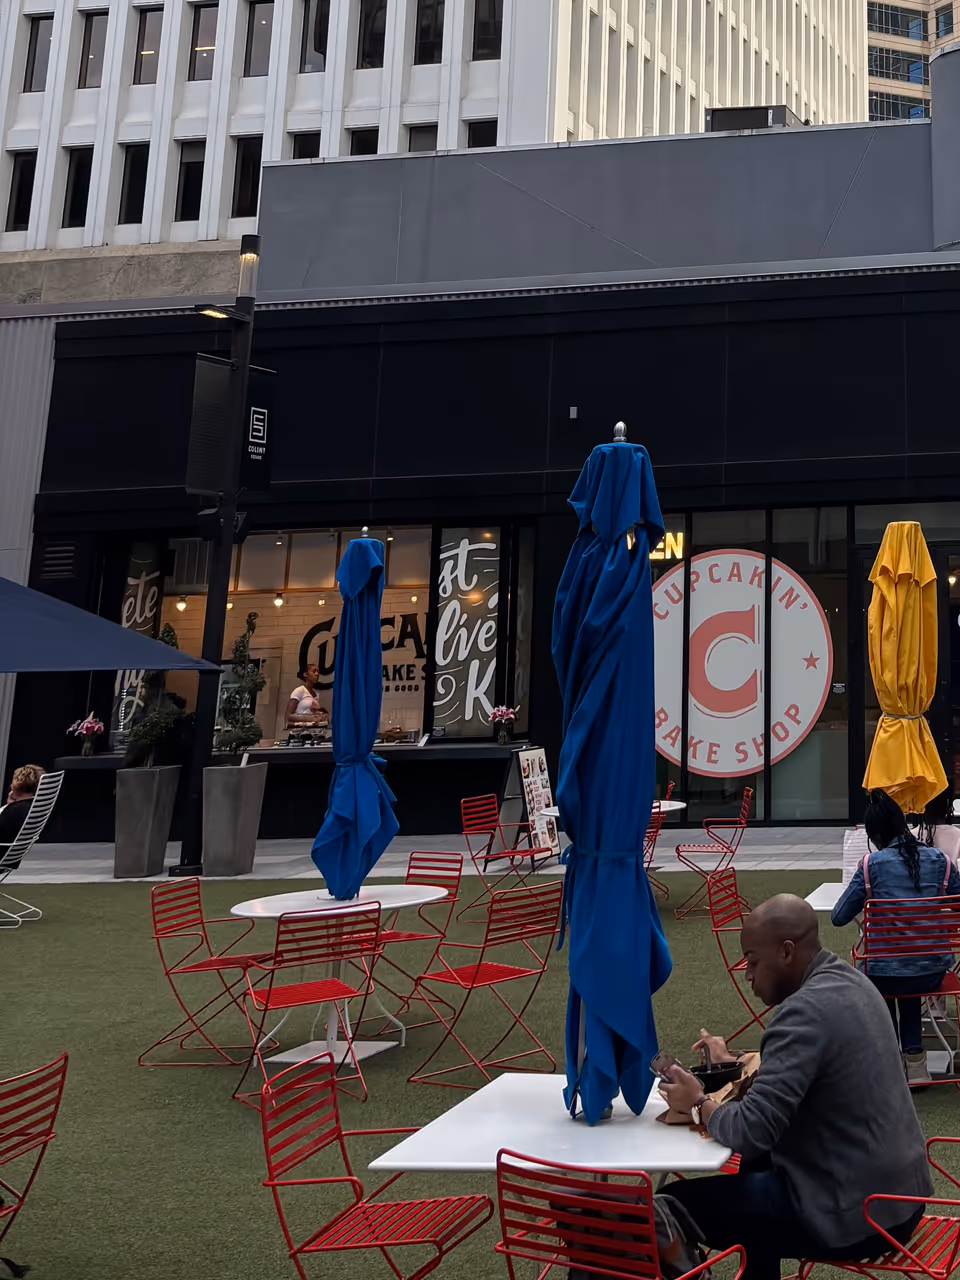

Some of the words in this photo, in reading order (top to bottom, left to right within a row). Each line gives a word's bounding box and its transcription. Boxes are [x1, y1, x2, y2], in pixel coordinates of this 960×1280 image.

[382, 664, 417, 681] AKE
[394, 684, 419, 692] GOOD
[655, 707, 721, 765] BAKE
[734, 703, 802, 763] SHOP
